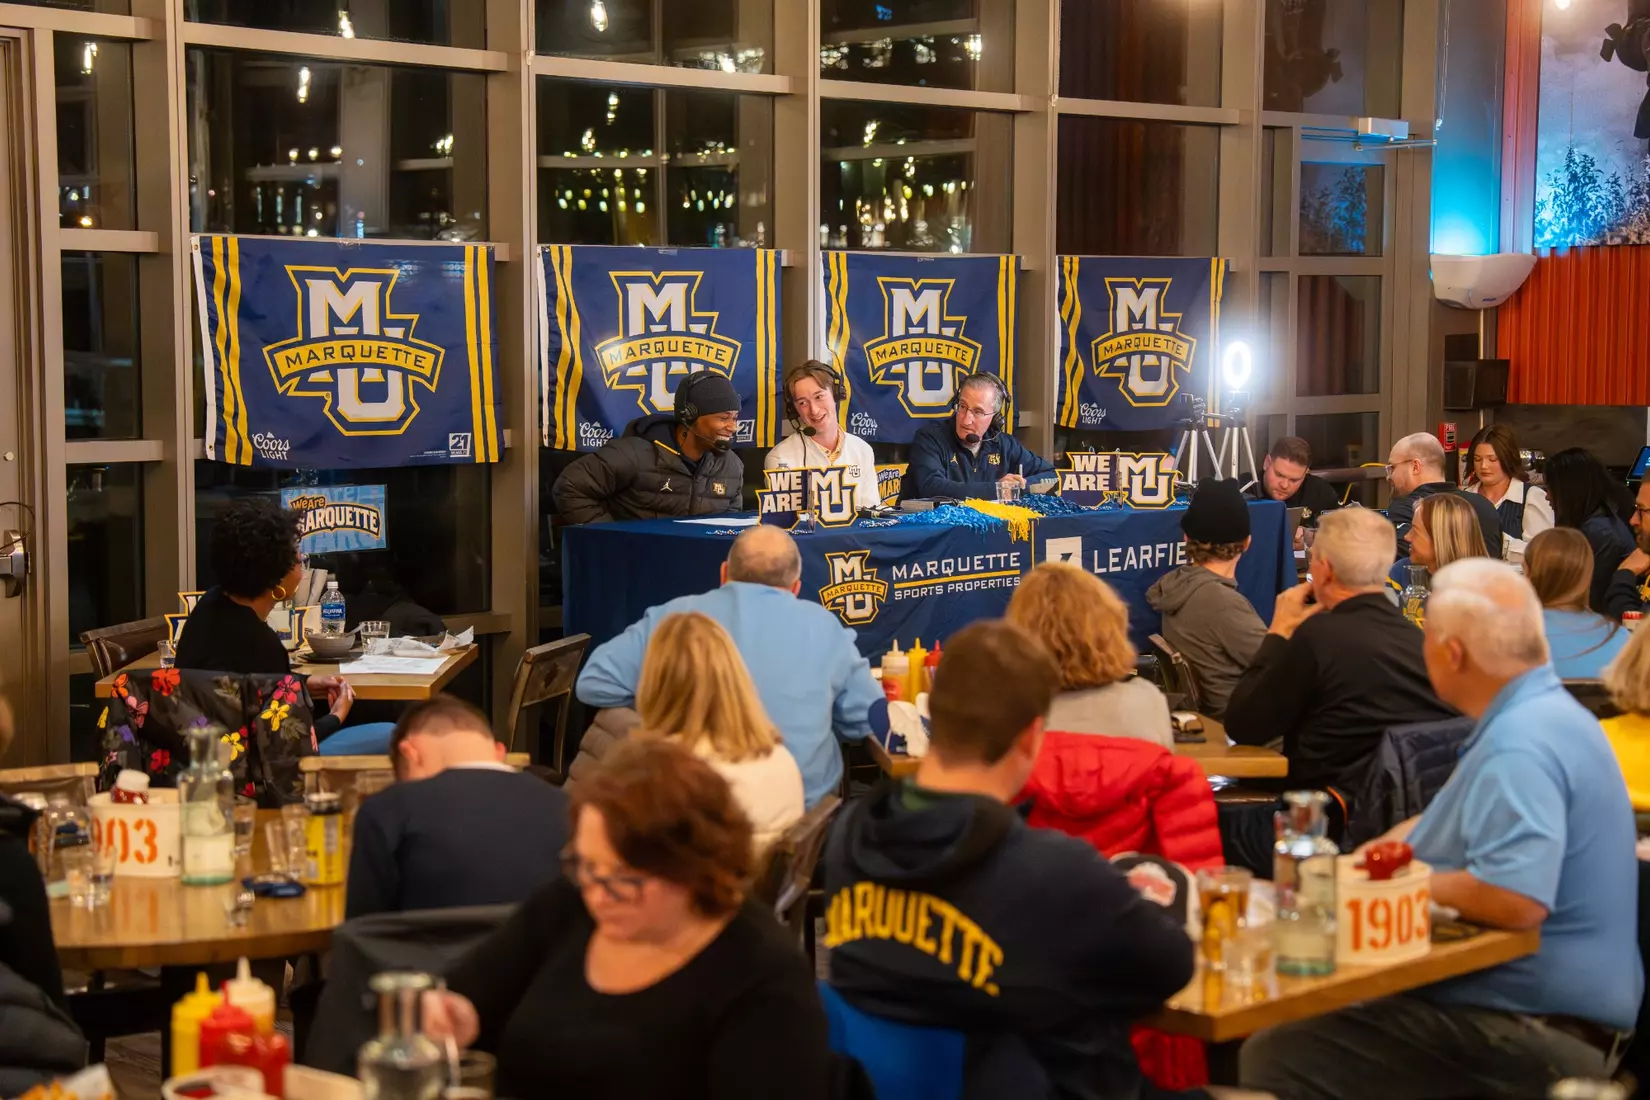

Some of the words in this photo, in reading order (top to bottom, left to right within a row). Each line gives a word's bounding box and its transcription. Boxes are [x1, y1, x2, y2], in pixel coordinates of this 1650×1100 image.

[608, 341, 727, 365] MARQUETTE
[875, 341, 968, 362] MARQUETTE
[1103, 337, 1183, 357] MARQUETTE
[284, 345, 427, 370] MARQUETTE
[1080, 402, 1106, 418] Coors
[738, 421, 753, 435] 21
[851, 412, 878, 428] Coors
[1081, 416, 1103, 424] LIGHT
[579, 421, 614, 439] Coors
[853, 427, 876, 436] LIGHT
[252, 432, 290, 451] Coors
[451, 434, 469, 449] 21
[582, 438, 608, 447] LIGHT
[260, 450, 288, 460] LIGHT
[1073, 455, 1111, 472] WE
[769, 471, 802, 492] WE
[1062, 474, 1110, 491] ARE
[1119, 457, 1170, 504] MU
[762, 492, 802, 513] ARE
[810, 470, 852, 522] MU
[891, 552, 1020, 581] MARQUETTE
[1093, 541, 1193, 574] LEARFIE
[826, 583, 883, 599] MARQUETTE
[894, 584, 944, 600] SPORTS
[947, 577, 1021, 593] PROPERTIES
[1347, 889, 1431, 951] 1903
